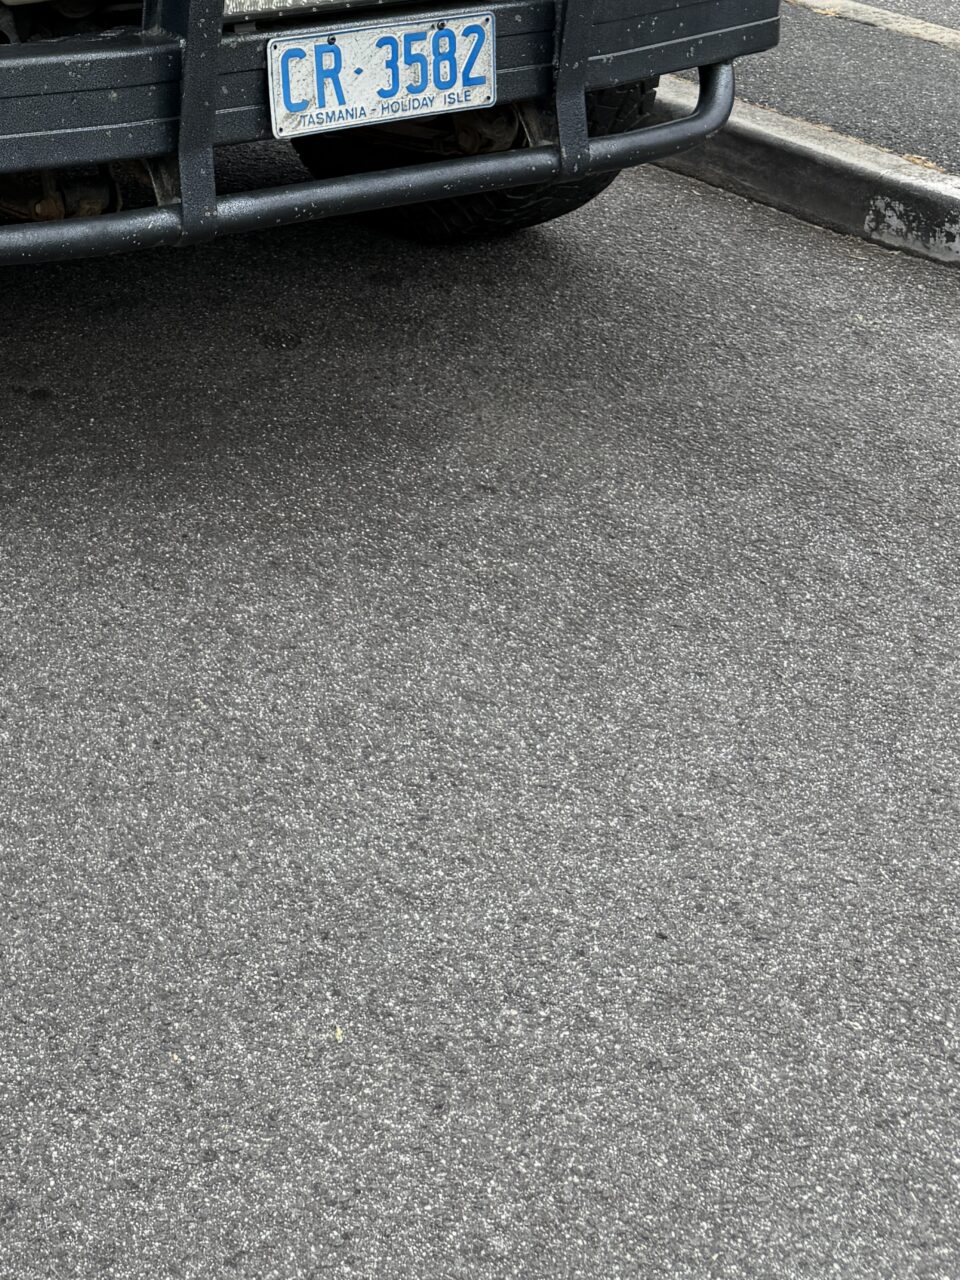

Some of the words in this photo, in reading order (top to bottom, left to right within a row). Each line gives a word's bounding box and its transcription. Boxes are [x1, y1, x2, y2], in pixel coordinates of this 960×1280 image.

[299, 108, 367, 128] TASMANIA
[381, 95, 436, 116] HOLIDAY
[443, 91, 472, 106] ISLE
